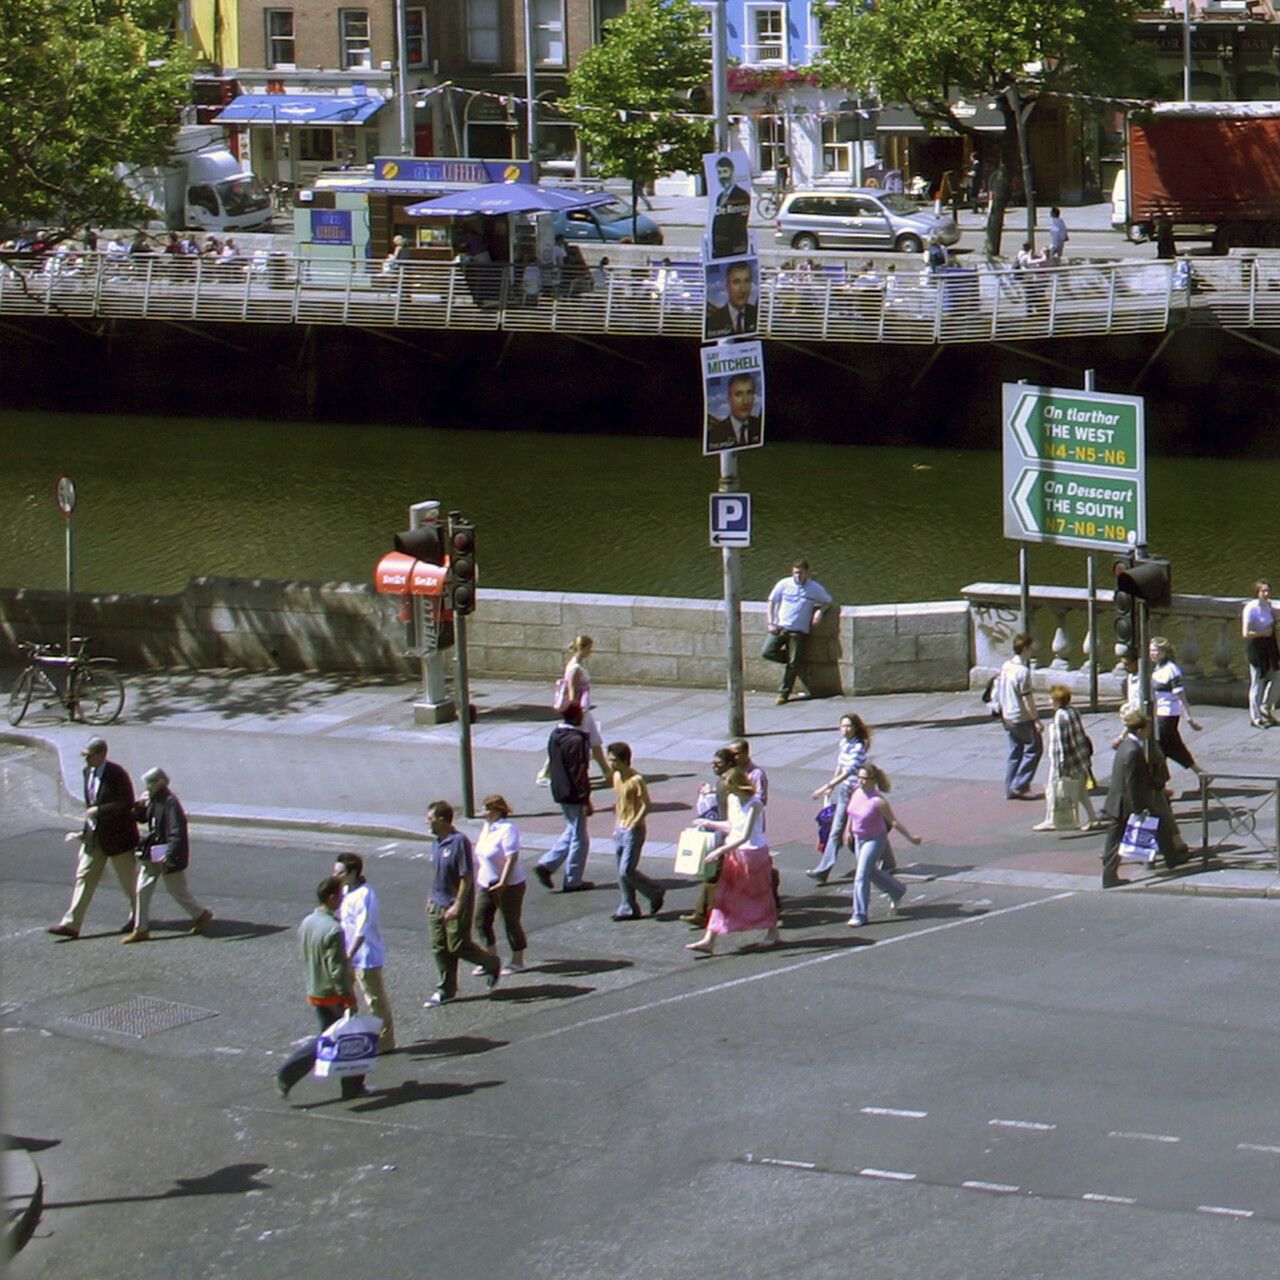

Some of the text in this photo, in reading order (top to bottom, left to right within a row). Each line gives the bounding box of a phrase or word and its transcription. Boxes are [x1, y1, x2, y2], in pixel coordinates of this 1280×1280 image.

[708, 356, 760, 374] MITCHELL
[1044, 405, 1063, 419] An
[1044, 423, 1115, 443] THE WEST
[1044, 480, 1064, 494] An
[718, 500, 743, 530] P
[1044, 498, 1124, 519] THE SOUTH
